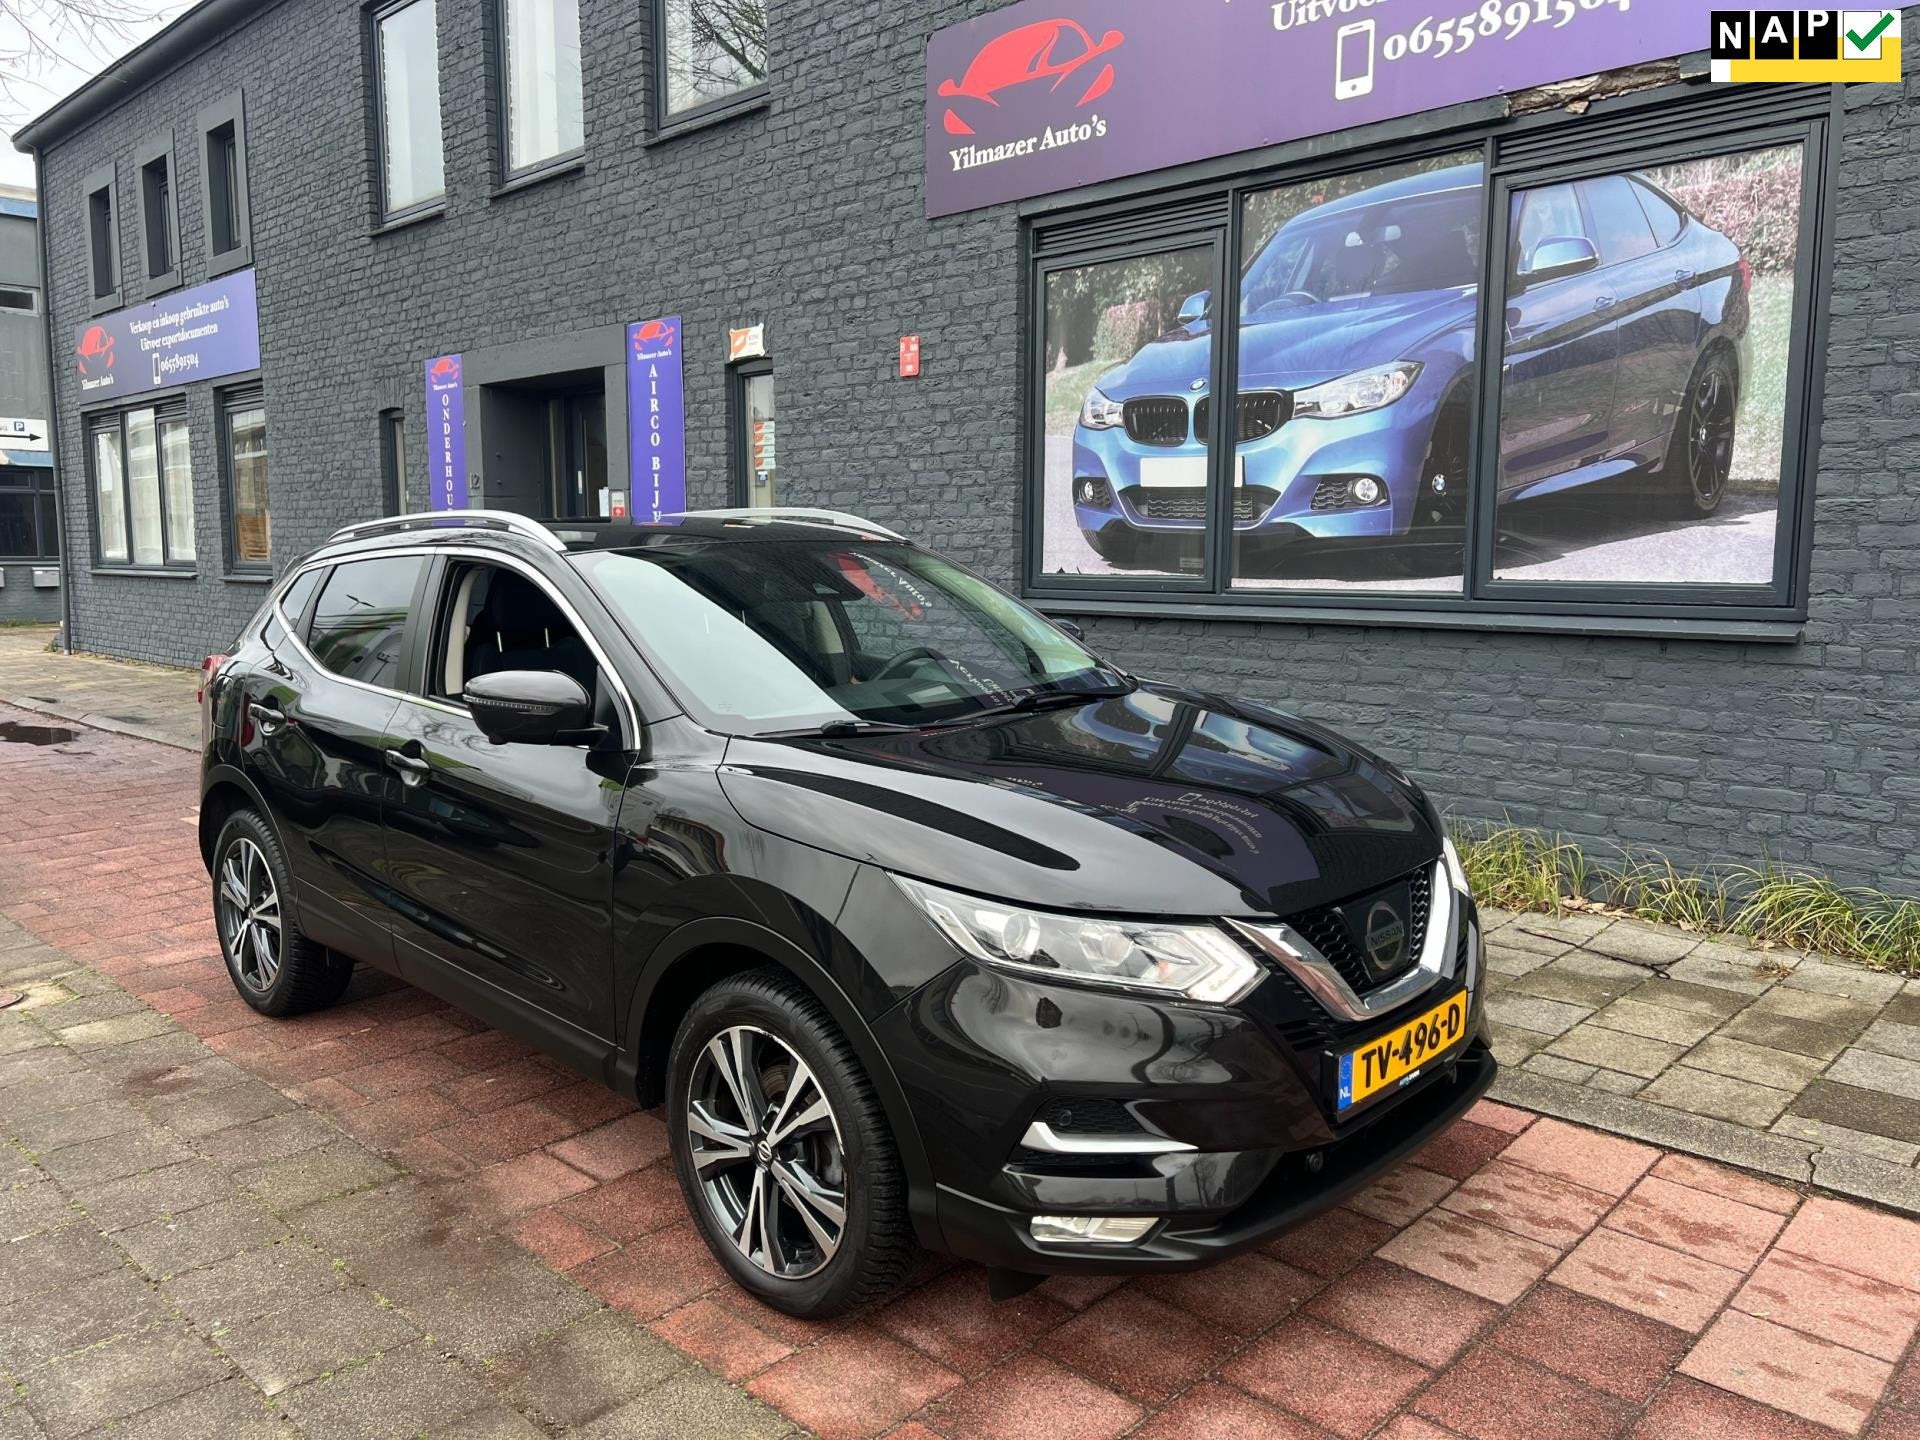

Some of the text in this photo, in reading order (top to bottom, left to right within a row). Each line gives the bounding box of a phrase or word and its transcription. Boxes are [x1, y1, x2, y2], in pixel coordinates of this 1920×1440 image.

[1271, 0, 1387, 31] Uitvo
[949, 114, 1107, 171] Yilmazer Auto's
[129, 319, 152, 334] Verkoop
[159, 311, 180, 327] inkoop
[179, 302, 210, 326] gebruikte
[649, 363, 660, 447] AIRCO
[441, 393, 454, 511] ONDERHOU
[1361, 1003, 1461, 1089] TV-496-D
[1339, 1087, 1351, 1100] NL
